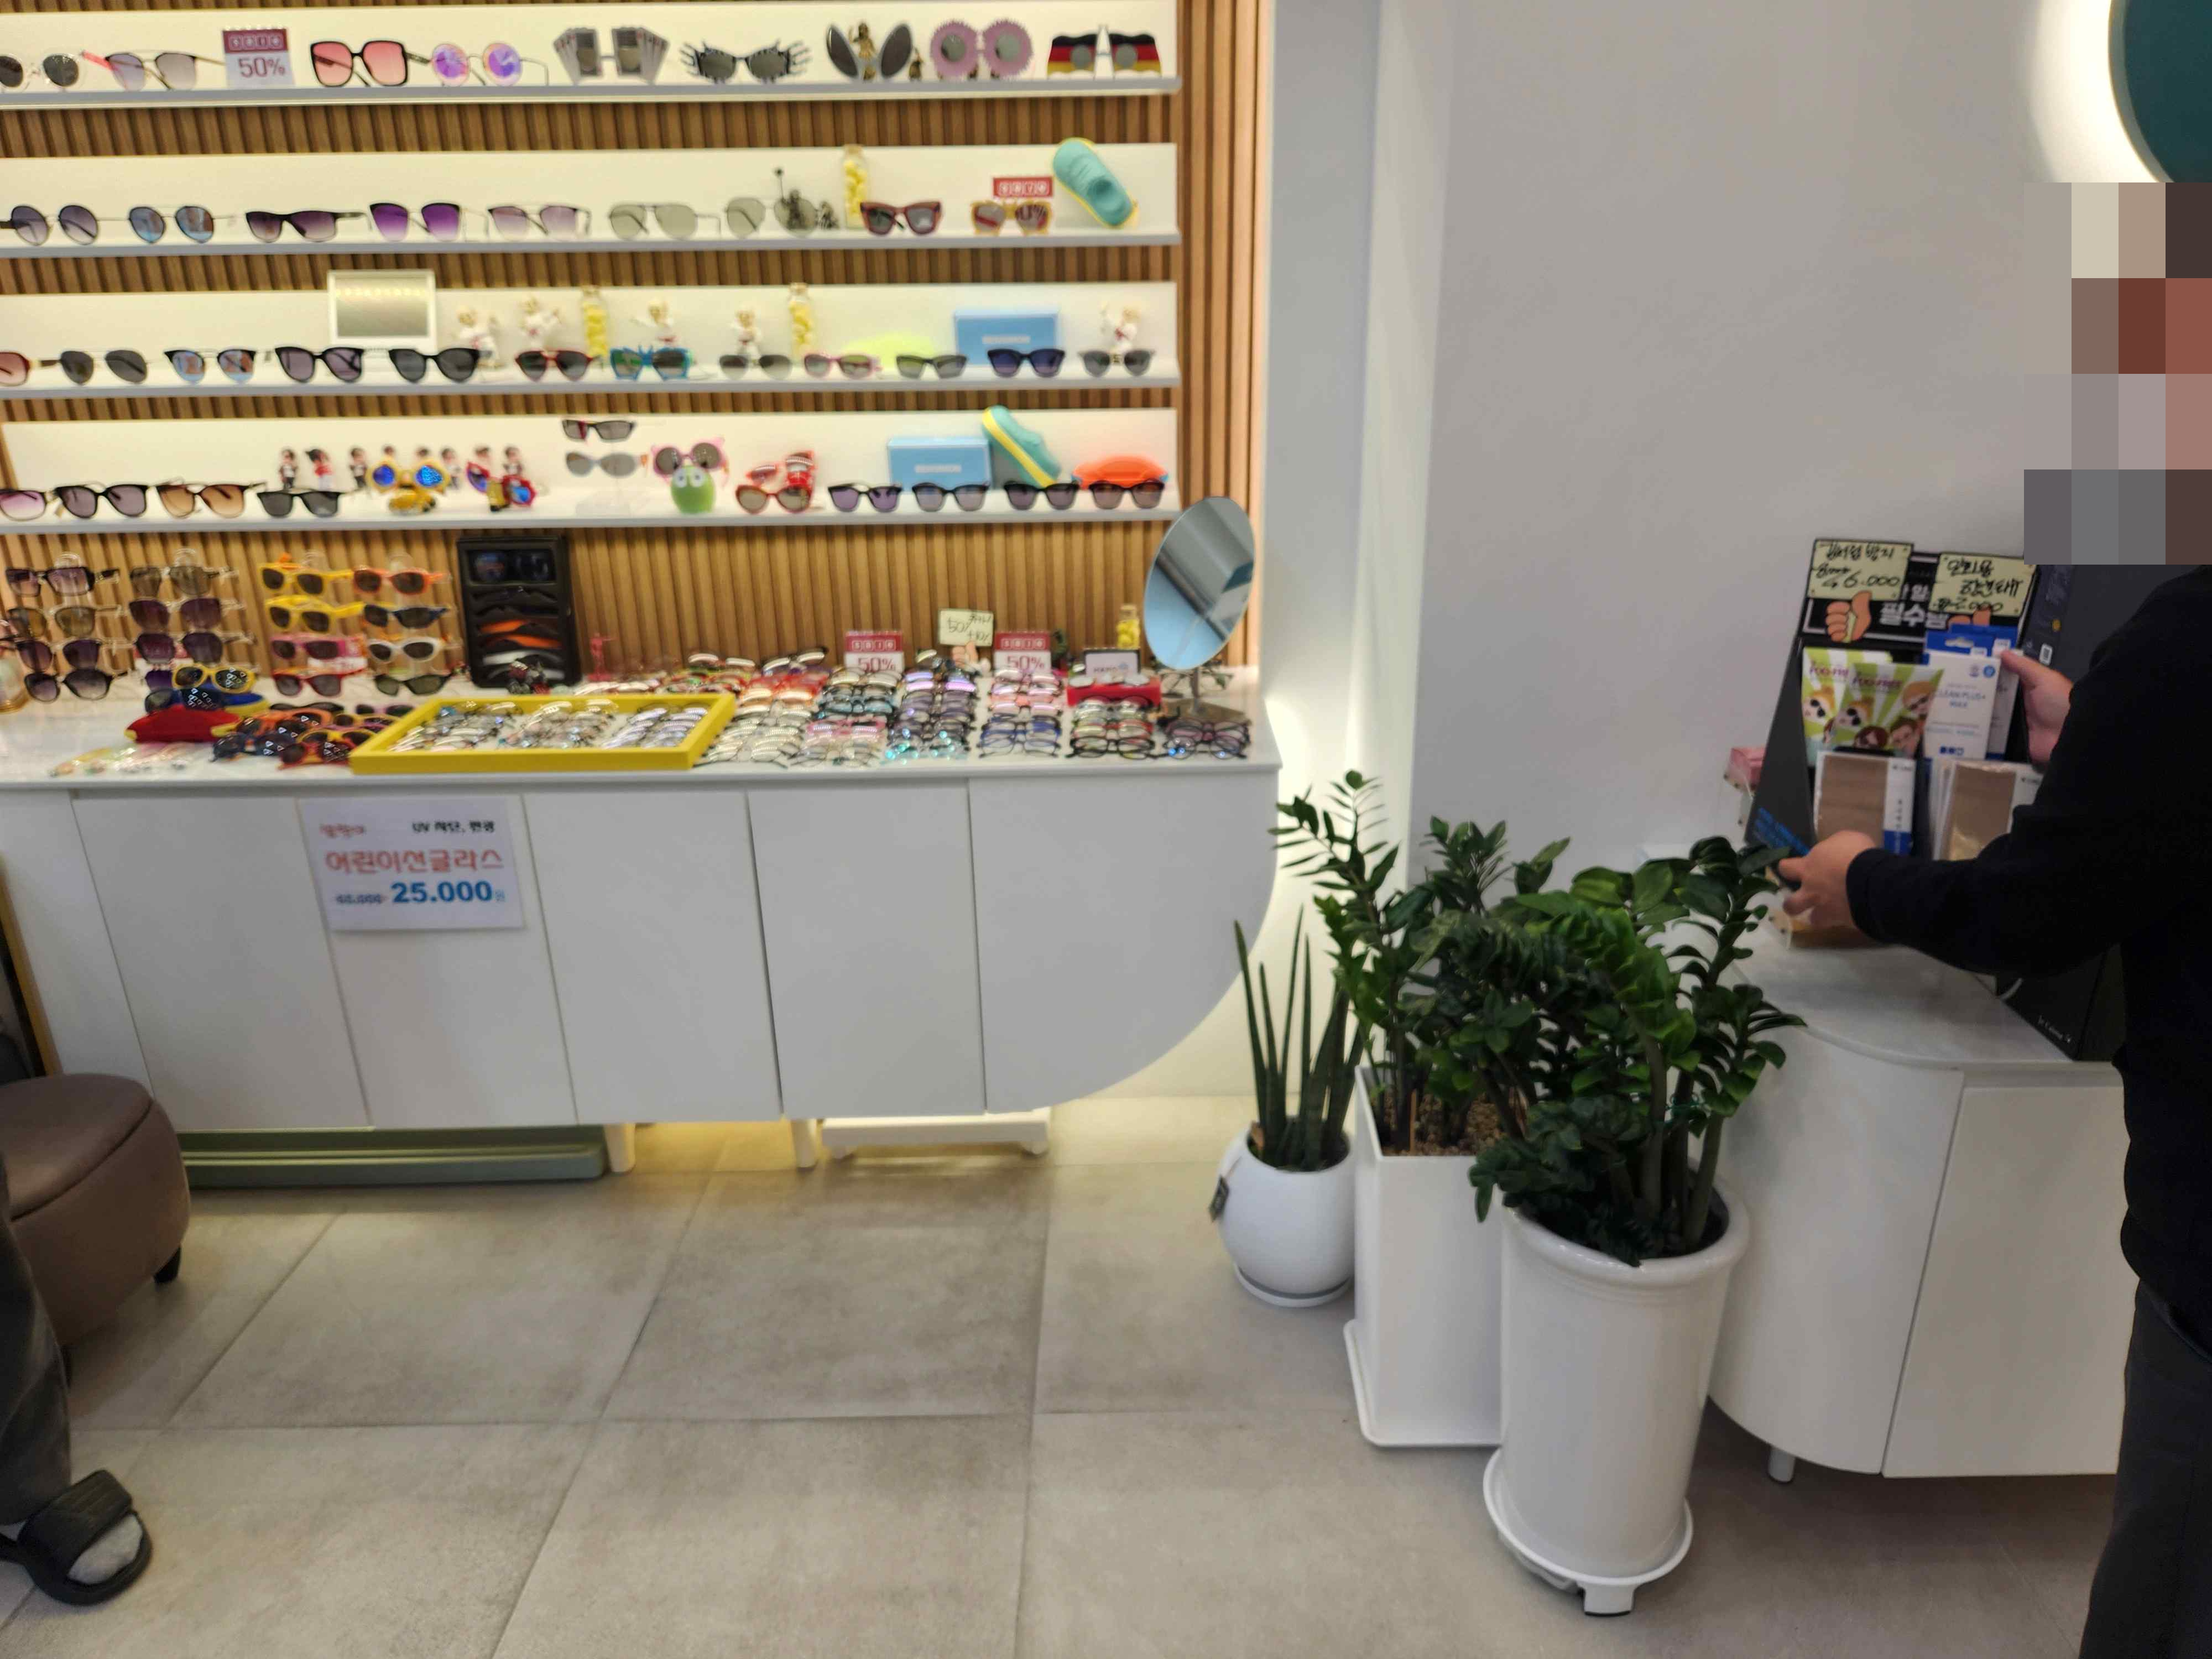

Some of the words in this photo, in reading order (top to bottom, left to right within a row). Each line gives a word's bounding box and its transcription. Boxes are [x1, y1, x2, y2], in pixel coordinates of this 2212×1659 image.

[238, 57, 286, 78] 50%
[858, 657, 894, 672] 50%
[1007, 655, 1045, 670] 50%
[412, 822, 430, 832] UV
[325, 848, 504, 875] 어린이선글라스
